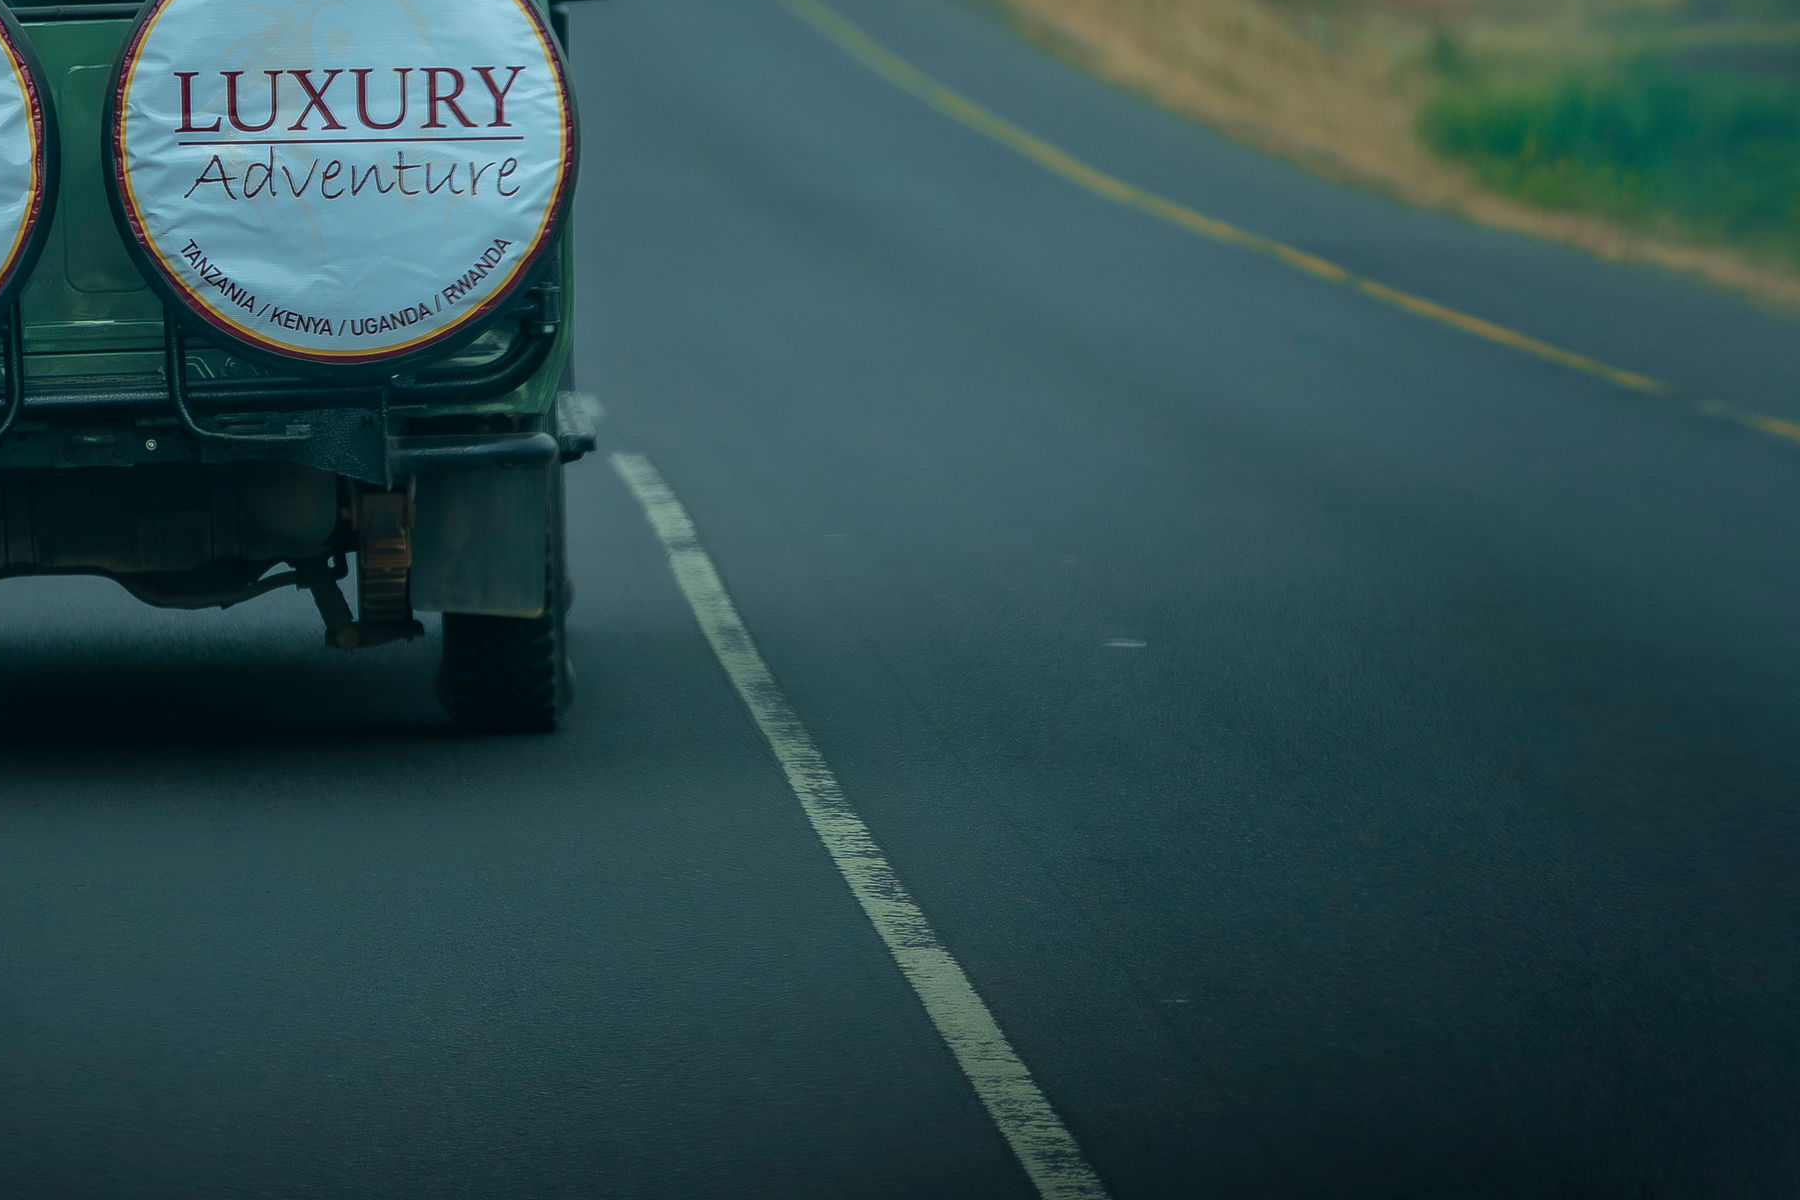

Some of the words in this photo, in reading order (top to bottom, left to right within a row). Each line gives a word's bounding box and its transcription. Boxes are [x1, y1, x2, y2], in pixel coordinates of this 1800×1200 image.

[174, 65, 526, 134] LUXURY
[183, 145, 521, 201] Adventure
[179, 238, 257, 314] TANZANIA
[270, 307, 334, 337] KENYA
[350, 302, 434, 337] UGANDA
[442, 237, 513, 306] RWANDA
